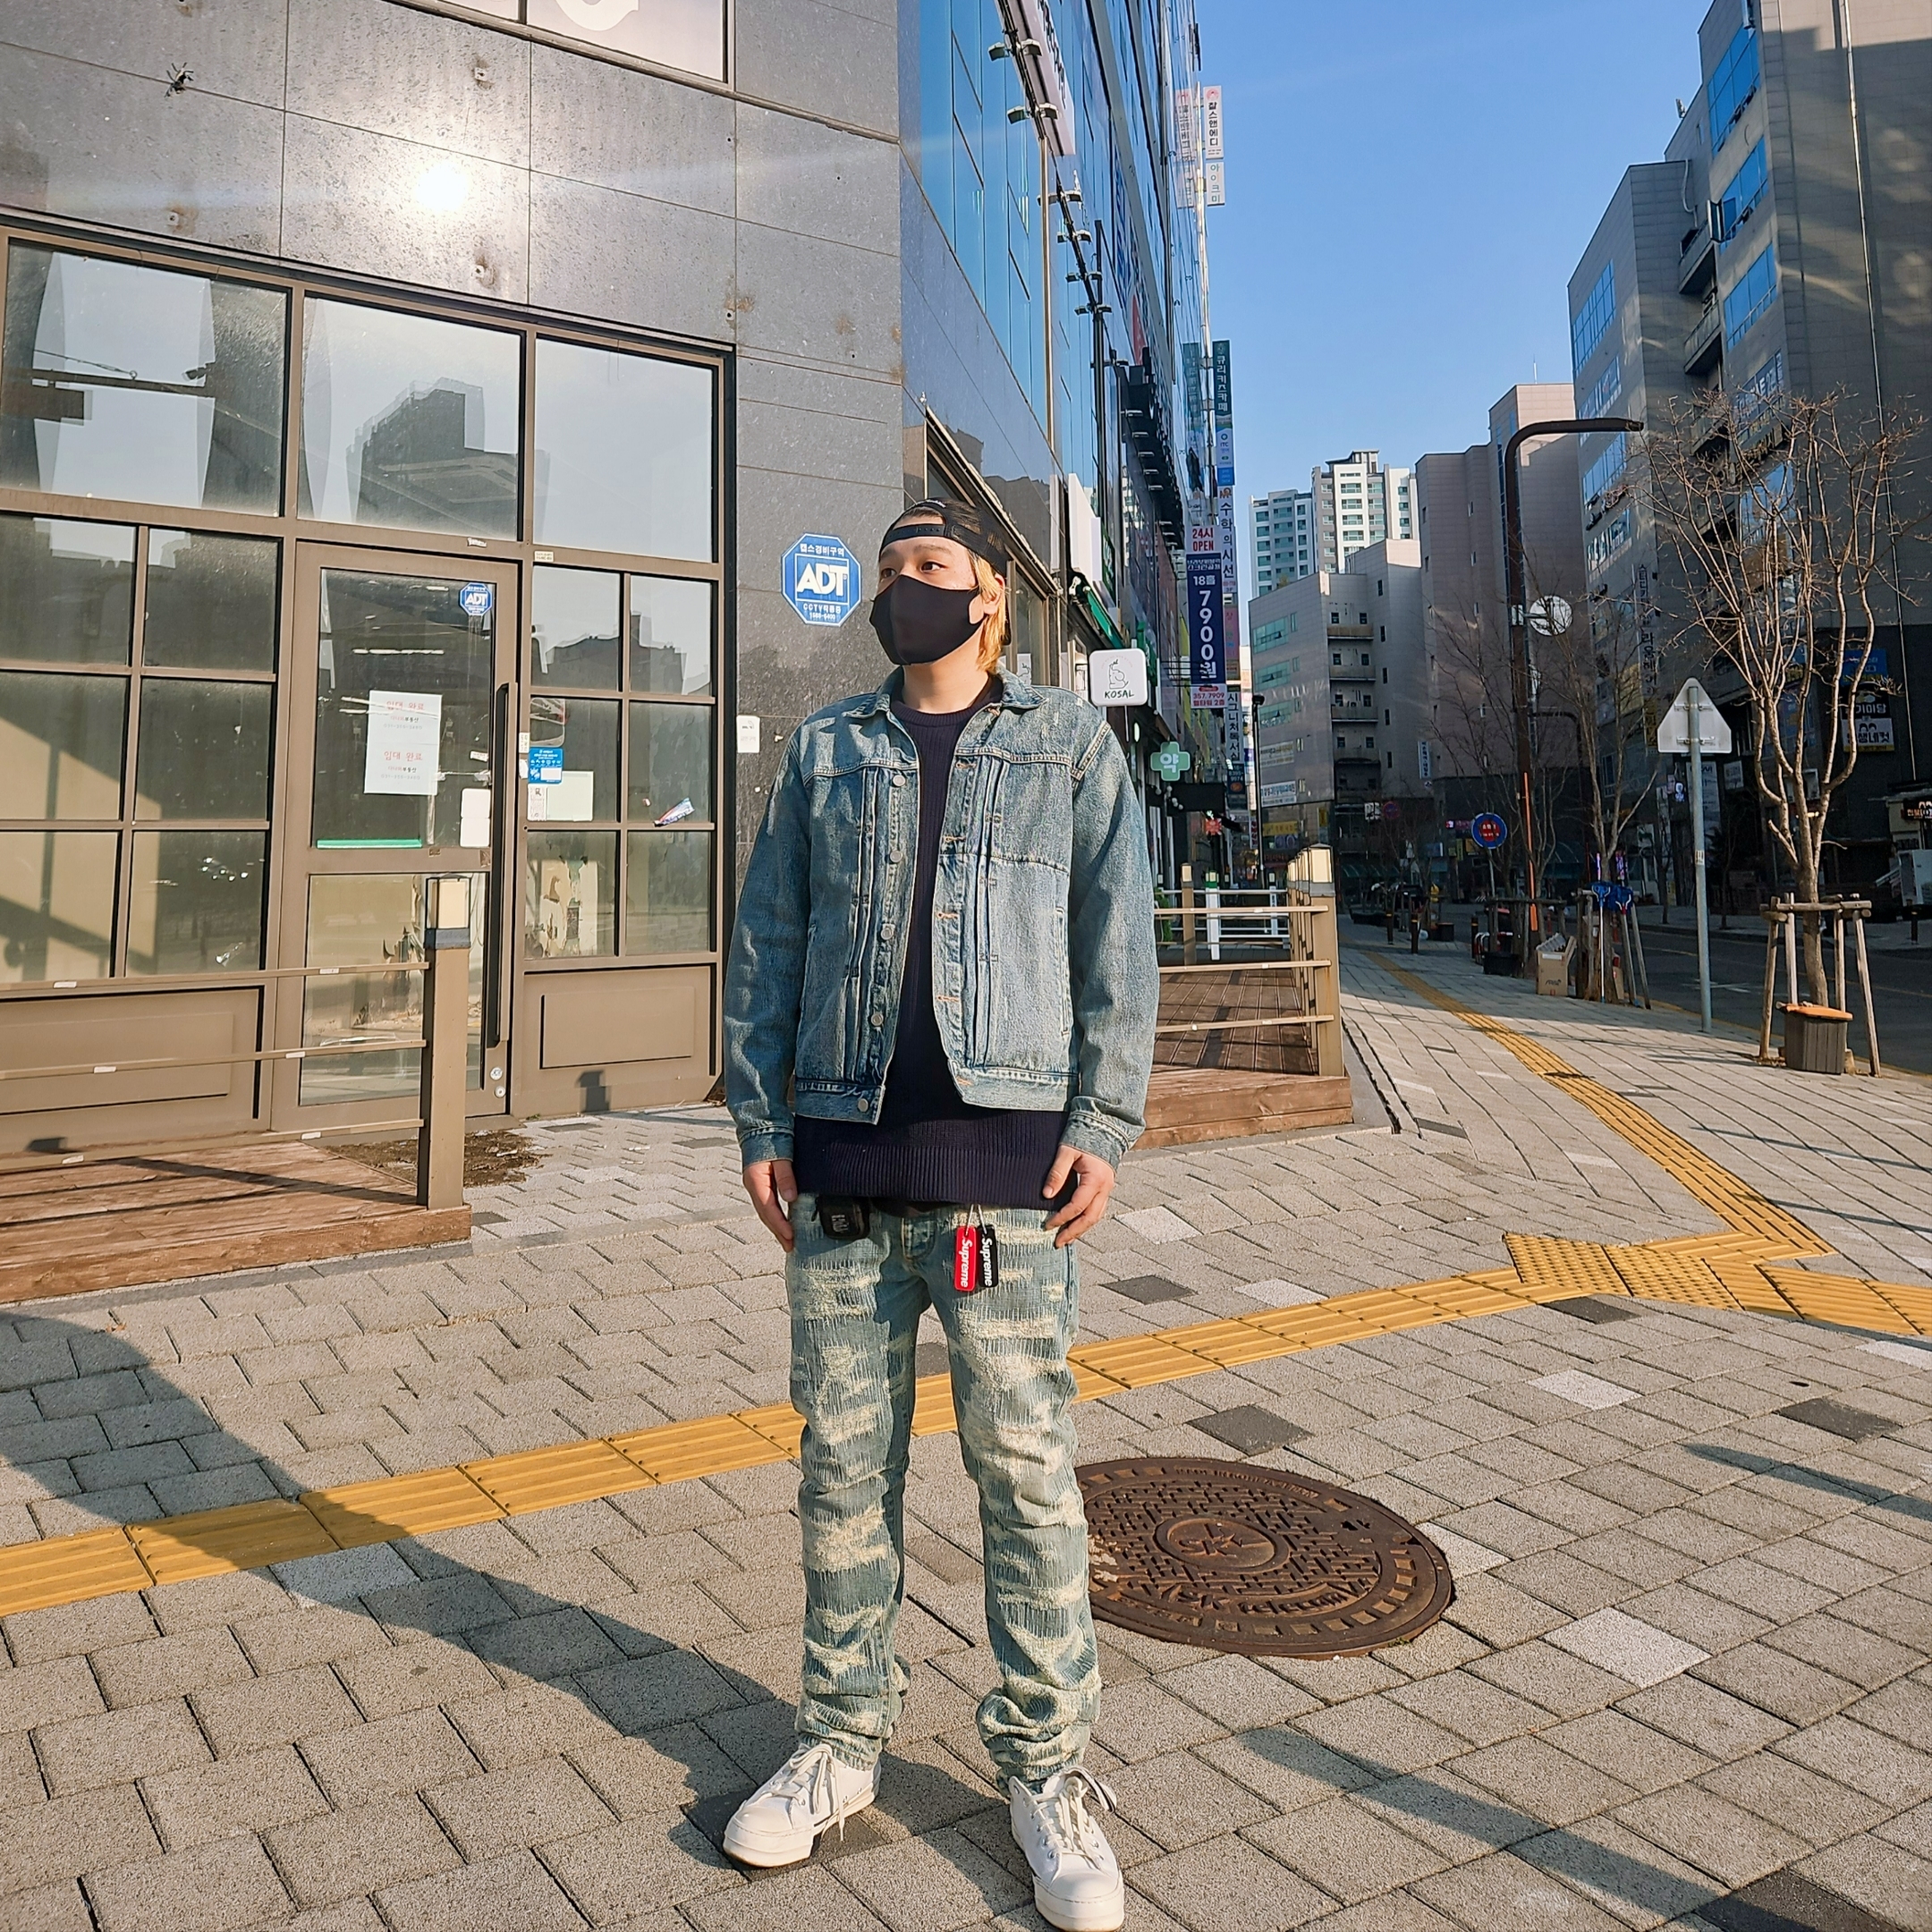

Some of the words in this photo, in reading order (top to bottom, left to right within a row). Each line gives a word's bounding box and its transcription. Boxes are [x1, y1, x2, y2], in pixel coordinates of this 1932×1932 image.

[1192, 528, 1214, 538] 24시
[1220, 503, 1234, 579] 수학의시선
[1192, 540, 1214, 552] OPEN
[796, 563, 848, 597] ADT
[466, 593, 487, 606] ADT
[1105, 690, 1135, 699] KOSAL
[384, 751, 401, 760] 임대
[406, 752, 423, 761] 완료
[1160, 753, 1179, 773] 약
[959, 1237, 972, 1287] Supreme
[979, 1237, 992, 1286] Supreme
